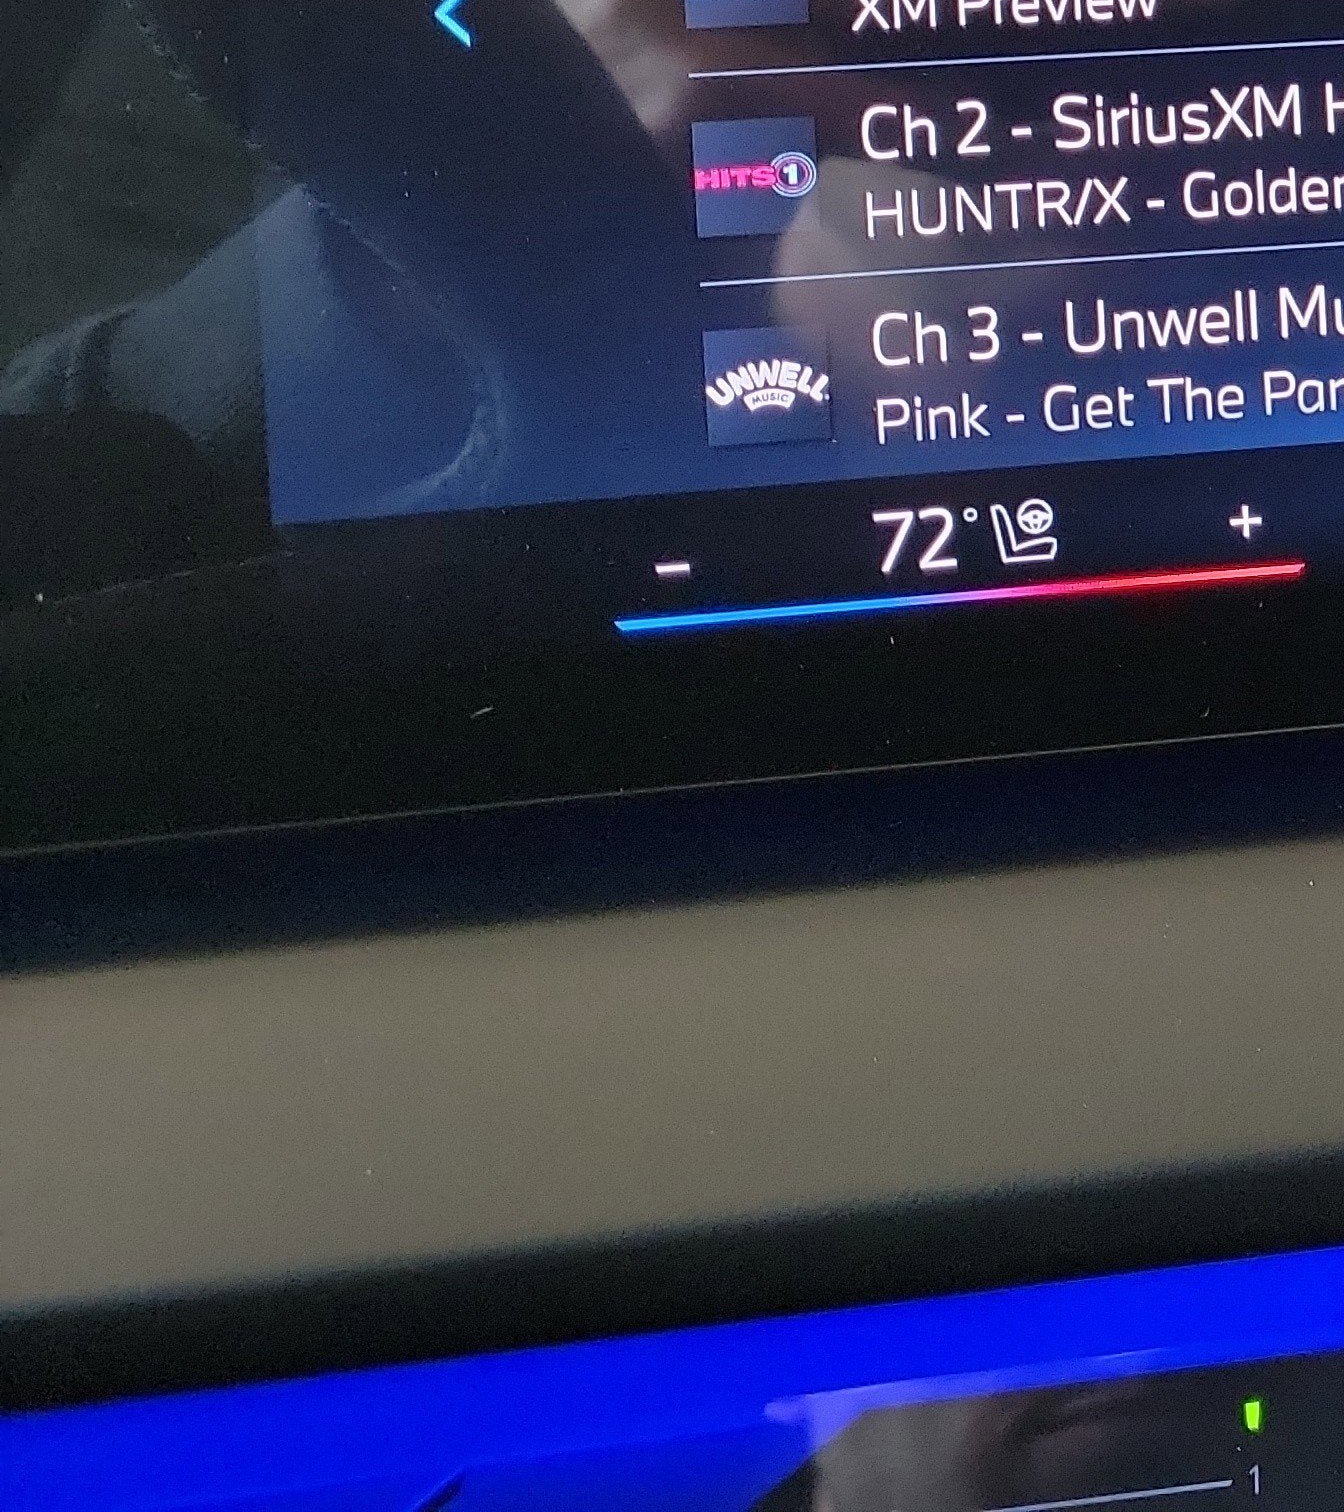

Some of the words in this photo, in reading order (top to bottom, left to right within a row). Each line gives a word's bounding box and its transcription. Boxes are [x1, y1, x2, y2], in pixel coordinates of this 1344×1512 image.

[861, 104, 937, 161] Ch
[956, 99, 991, 155] 2
[1052, 83, 1302, 150] SiriusXM
[865, 176, 1131, 240] HUNTR/X
[872, 310, 948, 367] Ch
[967, 305, 1000, 361] 3
[1065, 289, 1259, 354] Unwell
[751, 392, 790, 403] MUSIC
[876, 392, 991, 445] Pink
[1043, 384, 1135, 432] Get
[1146, 376, 1245, 423] The
[1248, 1464, 1260, 1495] 1
